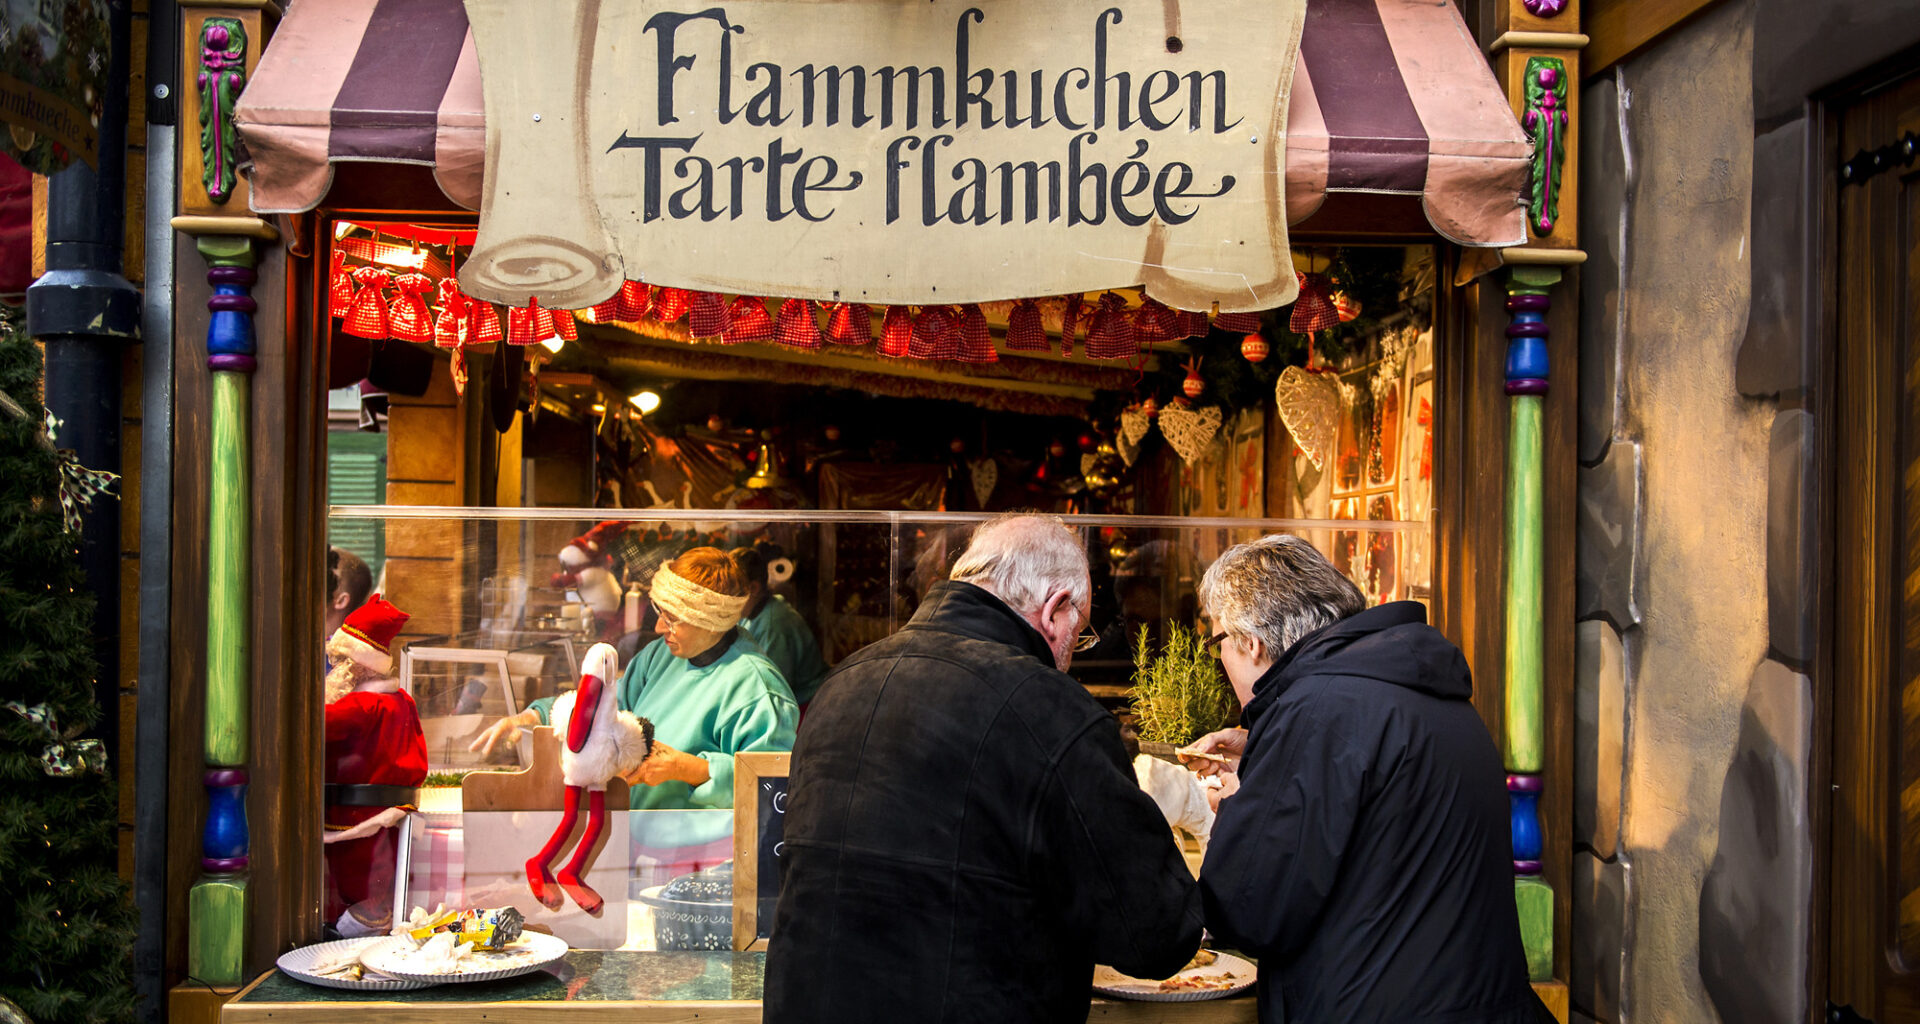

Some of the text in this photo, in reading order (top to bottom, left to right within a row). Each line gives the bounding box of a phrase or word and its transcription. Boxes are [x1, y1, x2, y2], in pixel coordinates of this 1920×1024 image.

[642, 7, 1244, 134] Flammkuchen
[606, 129, 1236, 228] Tarte flambée
